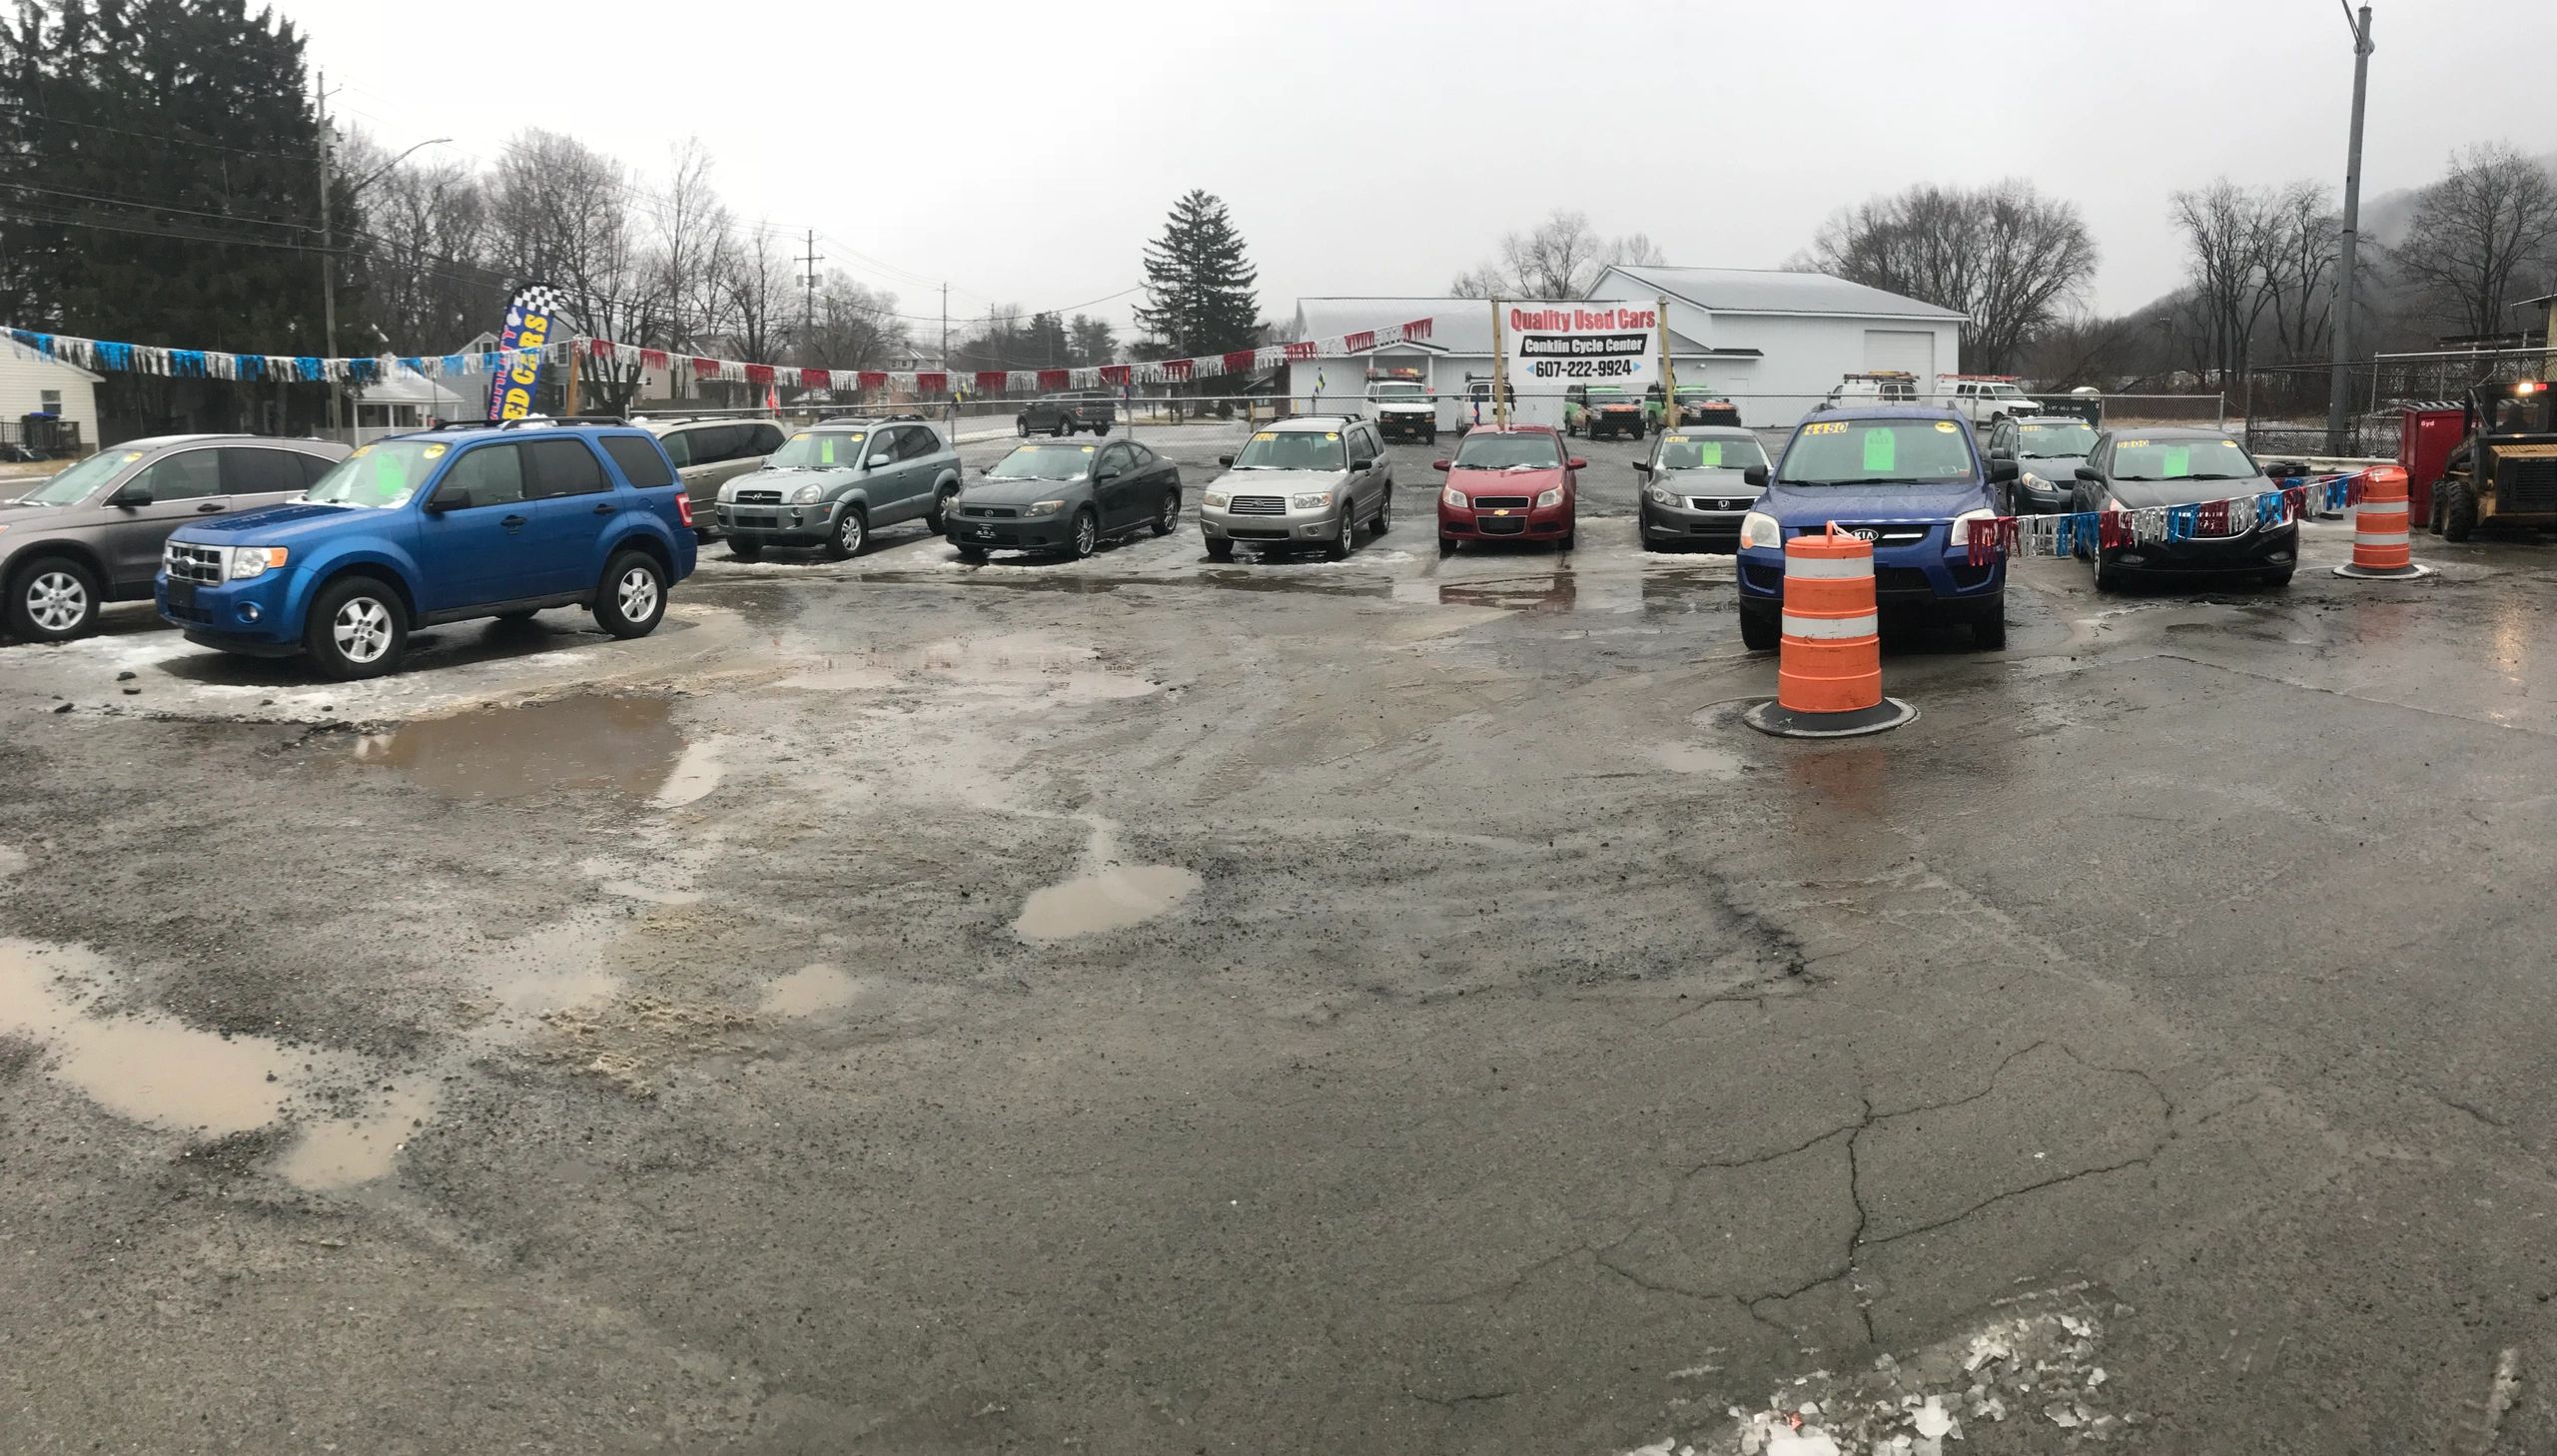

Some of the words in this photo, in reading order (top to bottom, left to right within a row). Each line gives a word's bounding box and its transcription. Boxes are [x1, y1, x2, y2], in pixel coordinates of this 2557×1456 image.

[1510, 309, 1571, 333] Quality
[1574, 310, 1615, 331] Used
[1618, 308, 1656, 330] Cars
[510, 314, 548, 385] CARS
[1524, 339, 1570, 353] Conklin
[1571, 339, 1604, 354] Cycle
[1605, 338, 1643, 353] Center
[1535, 360, 1632, 377] 607-222-9924
[1807, 421, 1848, 434] 4450
[1854, 531, 1874, 540] KIA
